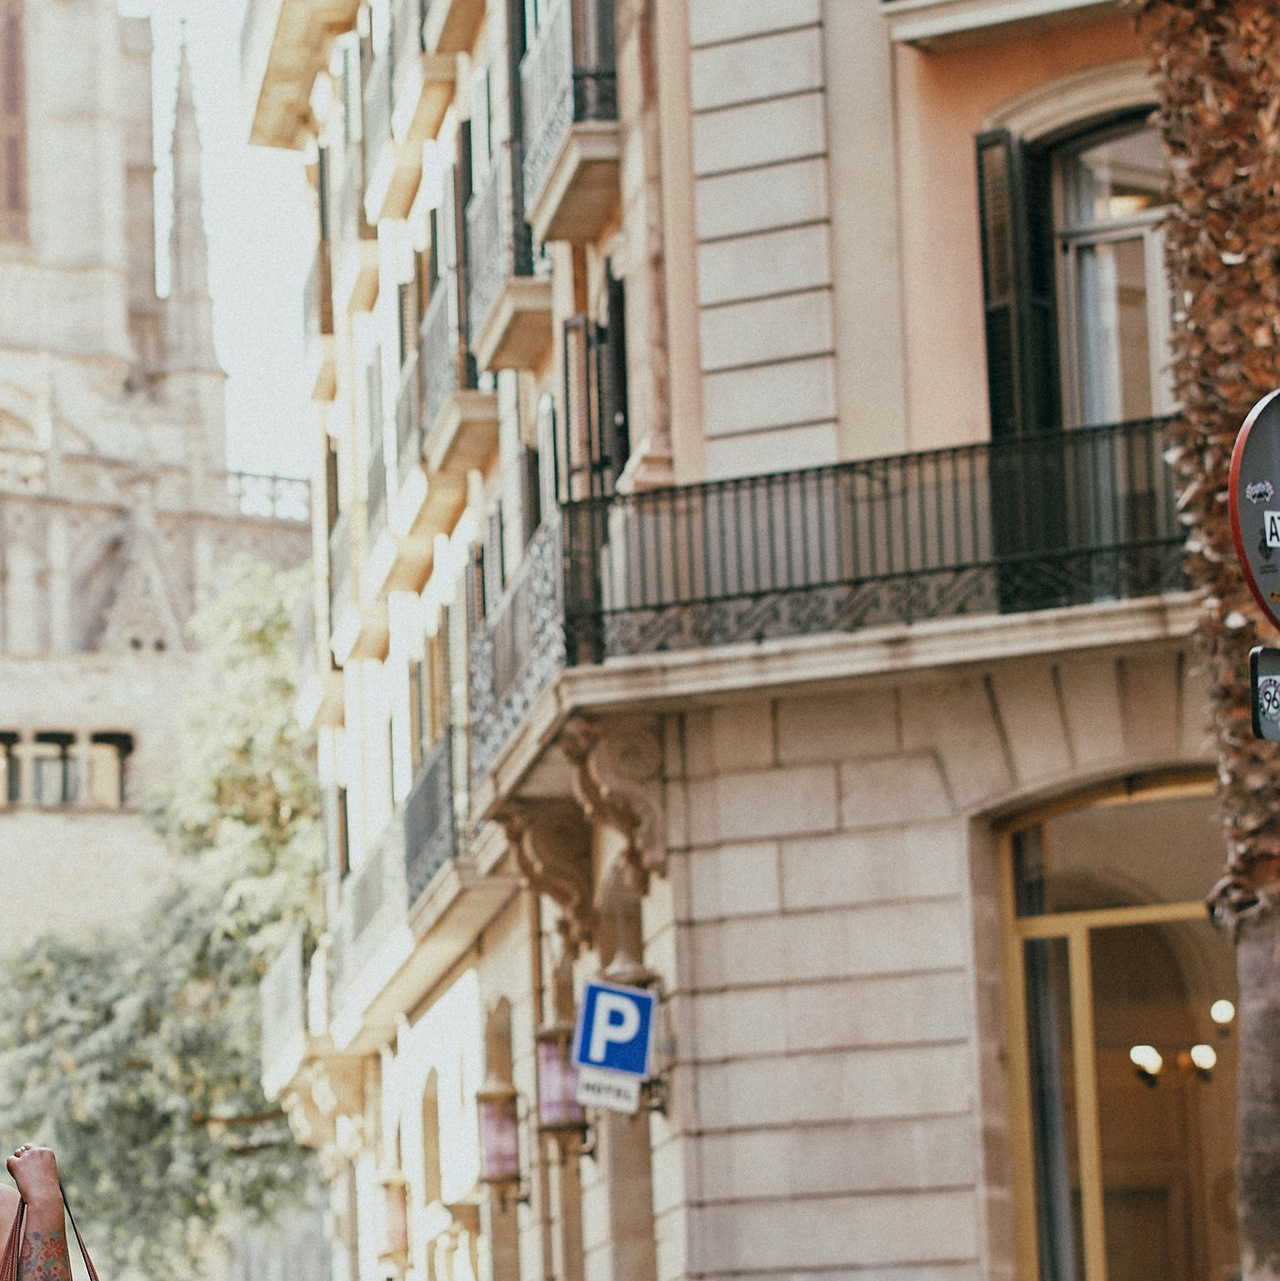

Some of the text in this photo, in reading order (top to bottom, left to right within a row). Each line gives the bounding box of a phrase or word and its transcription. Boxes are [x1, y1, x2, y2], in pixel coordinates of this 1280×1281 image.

[1264, 686, 1280, 711] 96
[589, 991, 641, 1063] P
[582, 1082, 631, 1100] HOTEL
